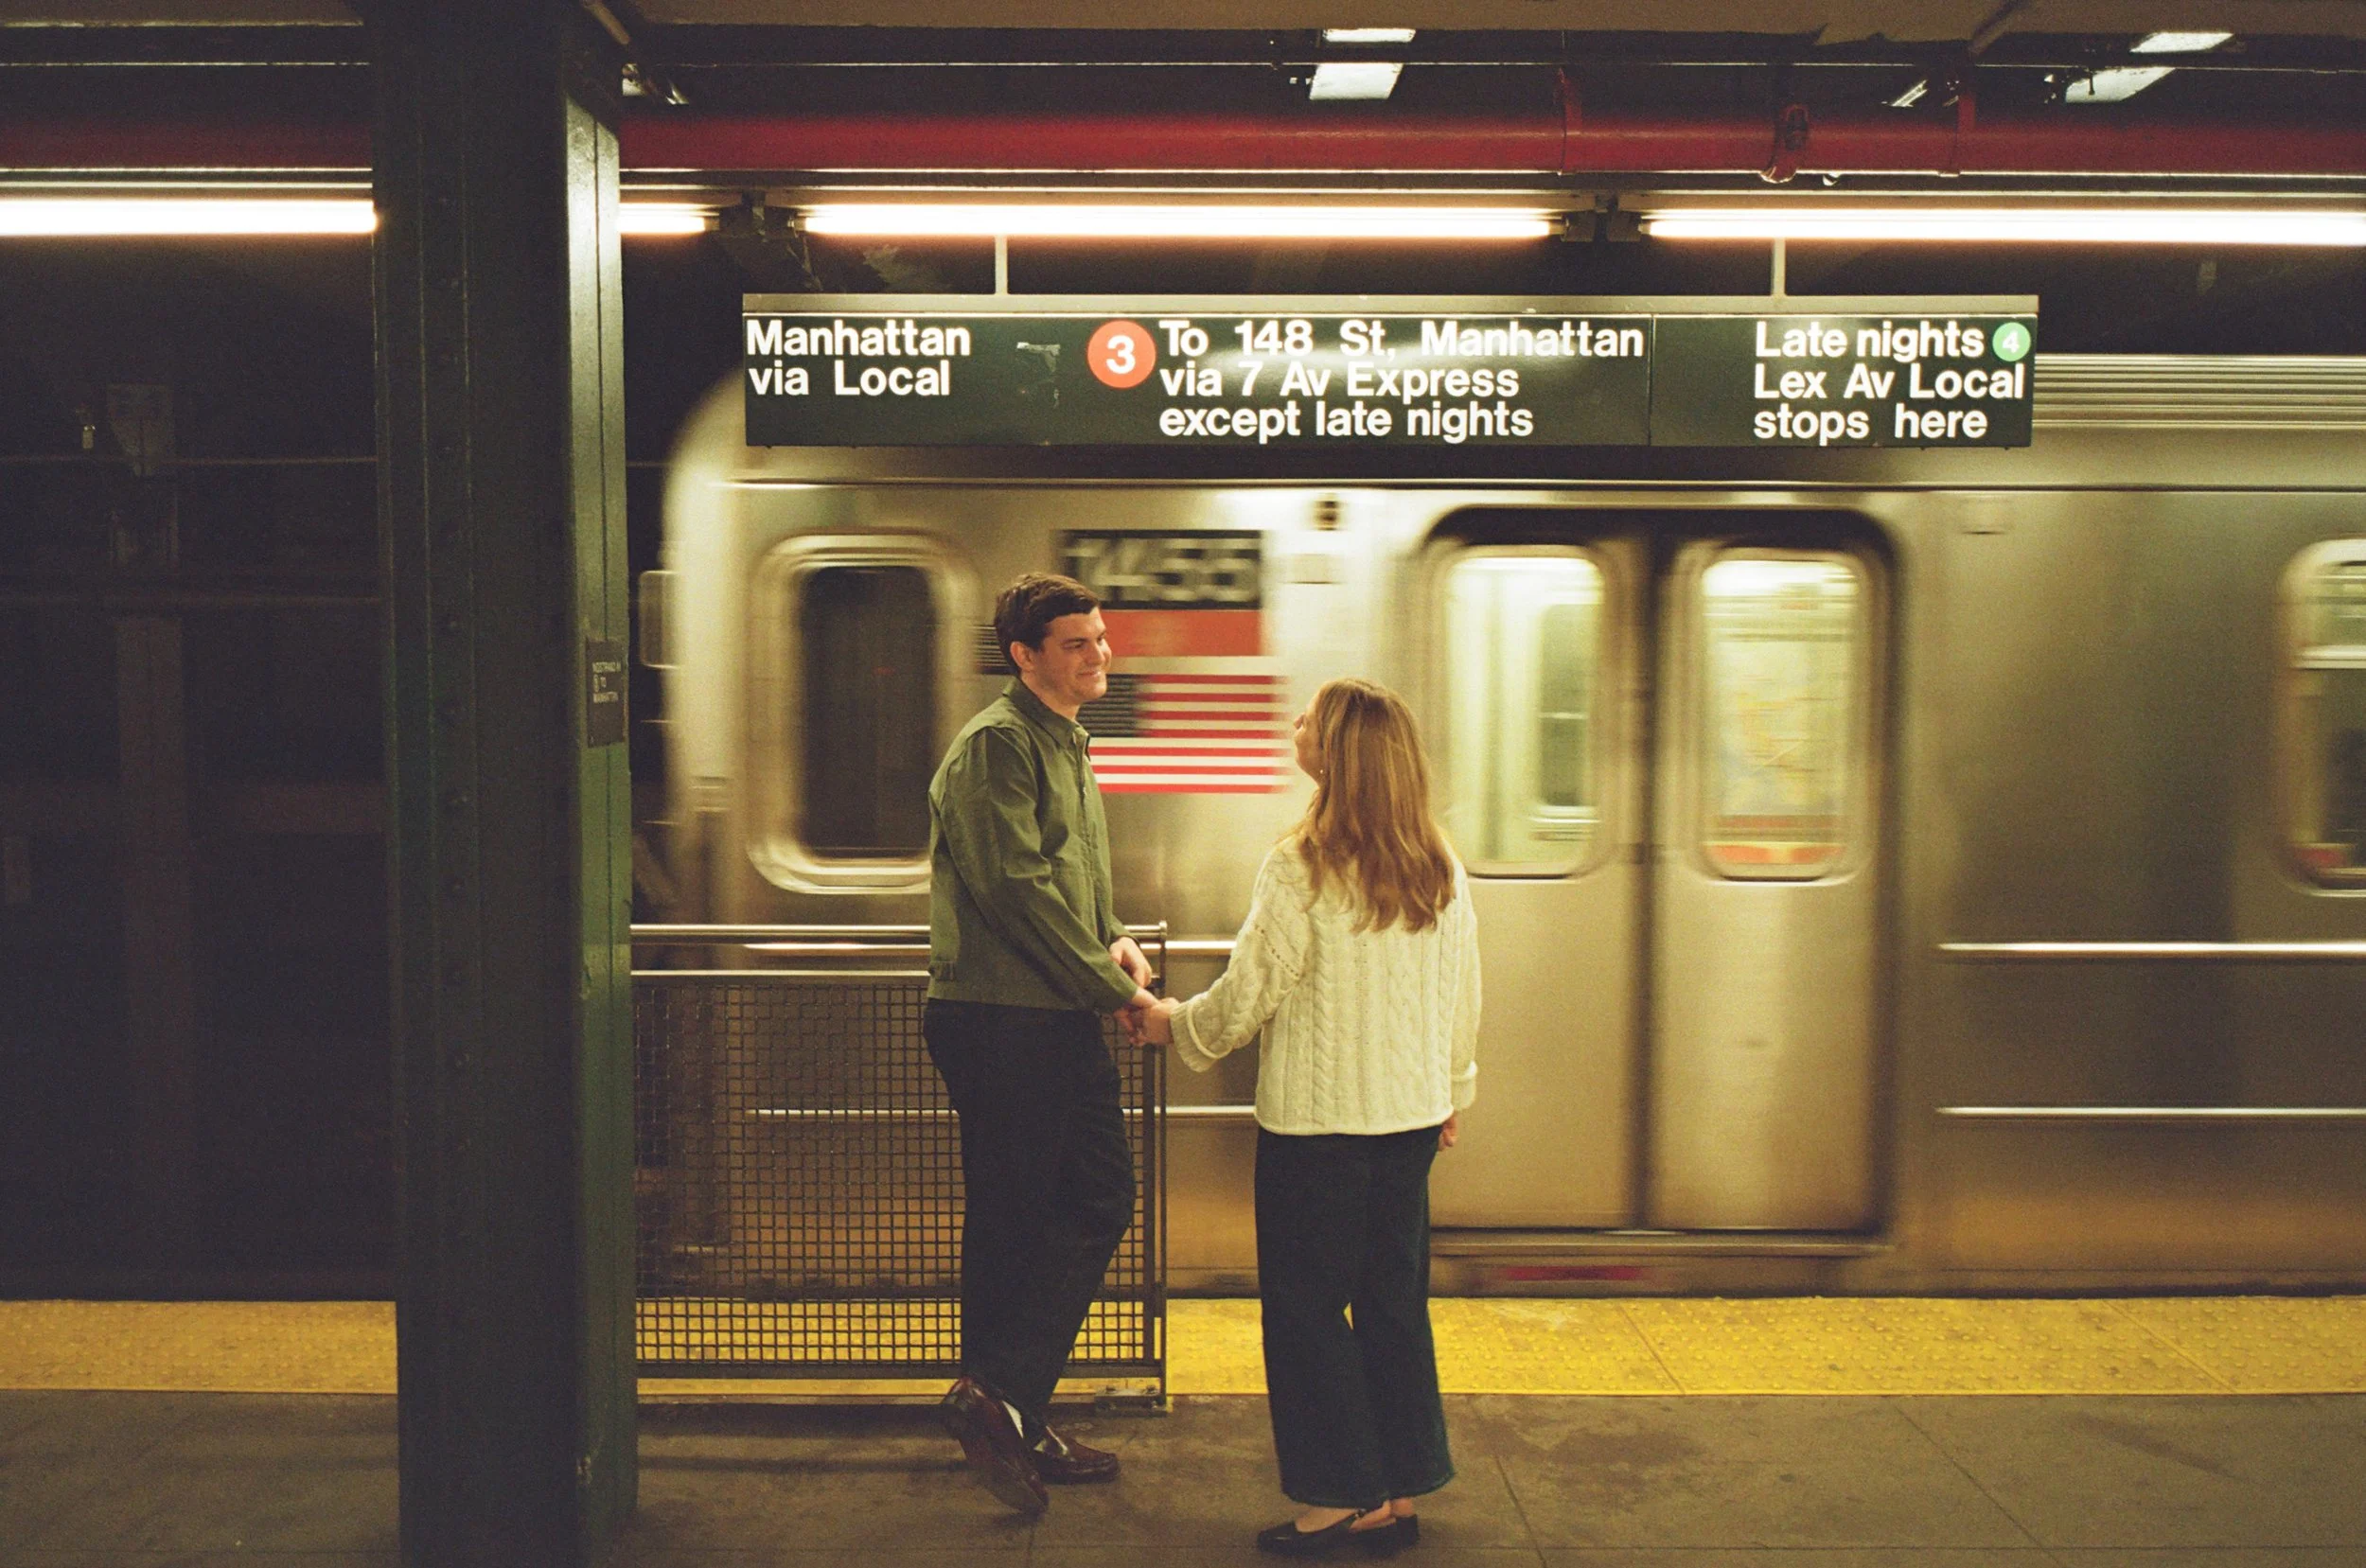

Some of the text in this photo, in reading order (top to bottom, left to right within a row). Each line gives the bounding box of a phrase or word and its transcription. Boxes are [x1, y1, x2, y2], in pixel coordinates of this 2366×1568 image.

[747, 319, 970, 357] Manhattan
[1105, 334, 1137, 375] 3
[1158, 320, 1209, 357] To
[1234, 319, 1314, 357] 148
[1421, 320, 1644, 358] Manhattan
[1756, 321, 1848, 358] Late
[1856, 321, 1985, 363] nights
[748, 360, 950, 396] via Local
[1159, 360, 1520, 405] via 7 Av Express
[1754, 362, 2024, 399] Lex Av Local
[1158, 400, 1534, 445] except late nights
[1753, 403, 1987, 447] stops here
